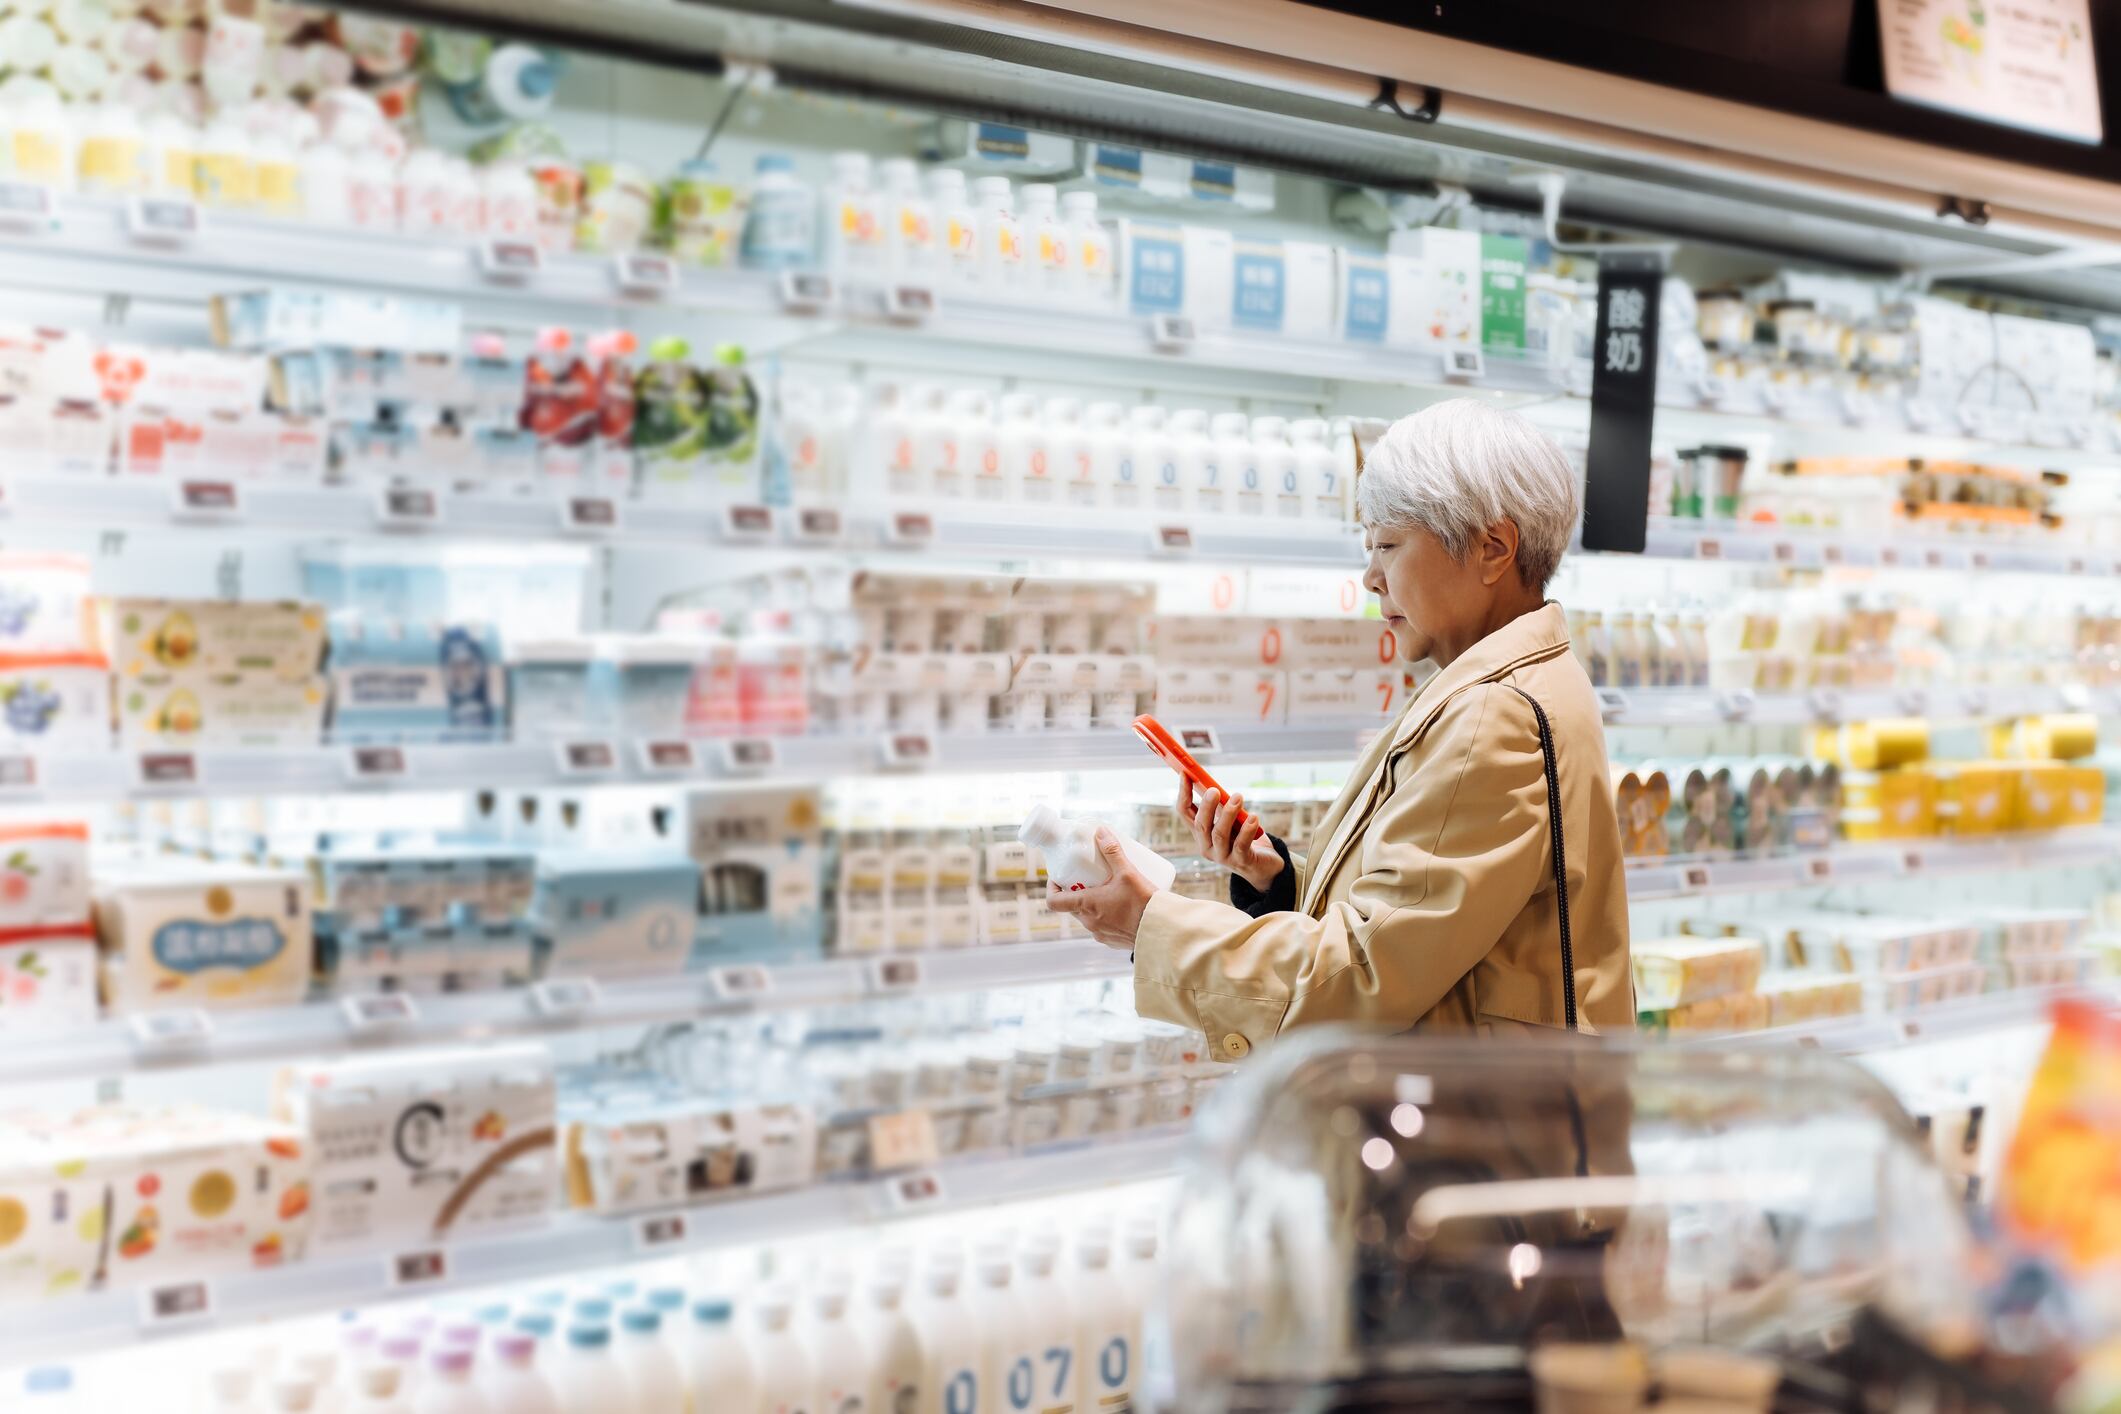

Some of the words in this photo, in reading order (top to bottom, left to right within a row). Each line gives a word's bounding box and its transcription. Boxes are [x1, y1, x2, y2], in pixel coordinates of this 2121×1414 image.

[1605, 287, 1647, 373] 酸奶
[1120, 458, 1132, 482] 0
[1162, 462, 1175, 485] 0
[1206, 464, 1218, 487] 7
[1244, 467, 1257, 490] 0
[1284, 470, 1297, 492] 0
[1323, 472, 1335, 494] 7
[1212, 575, 1234, 611] 0
[1340, 579, 1357, 613] 0
[1259, 627, 1283, 666] 0
[1377, 628, 1397, 665] 0
[1256, 681, 1278, 719] 7
[1376, 682, 1395, 714] 7
[1044, 1346, 1071, 1398] 7
[1100, 1336, 1129, 1388] 0
[945, 1368, 977, 1414] 0
[1008, 1356, 1035, 1410] 0
